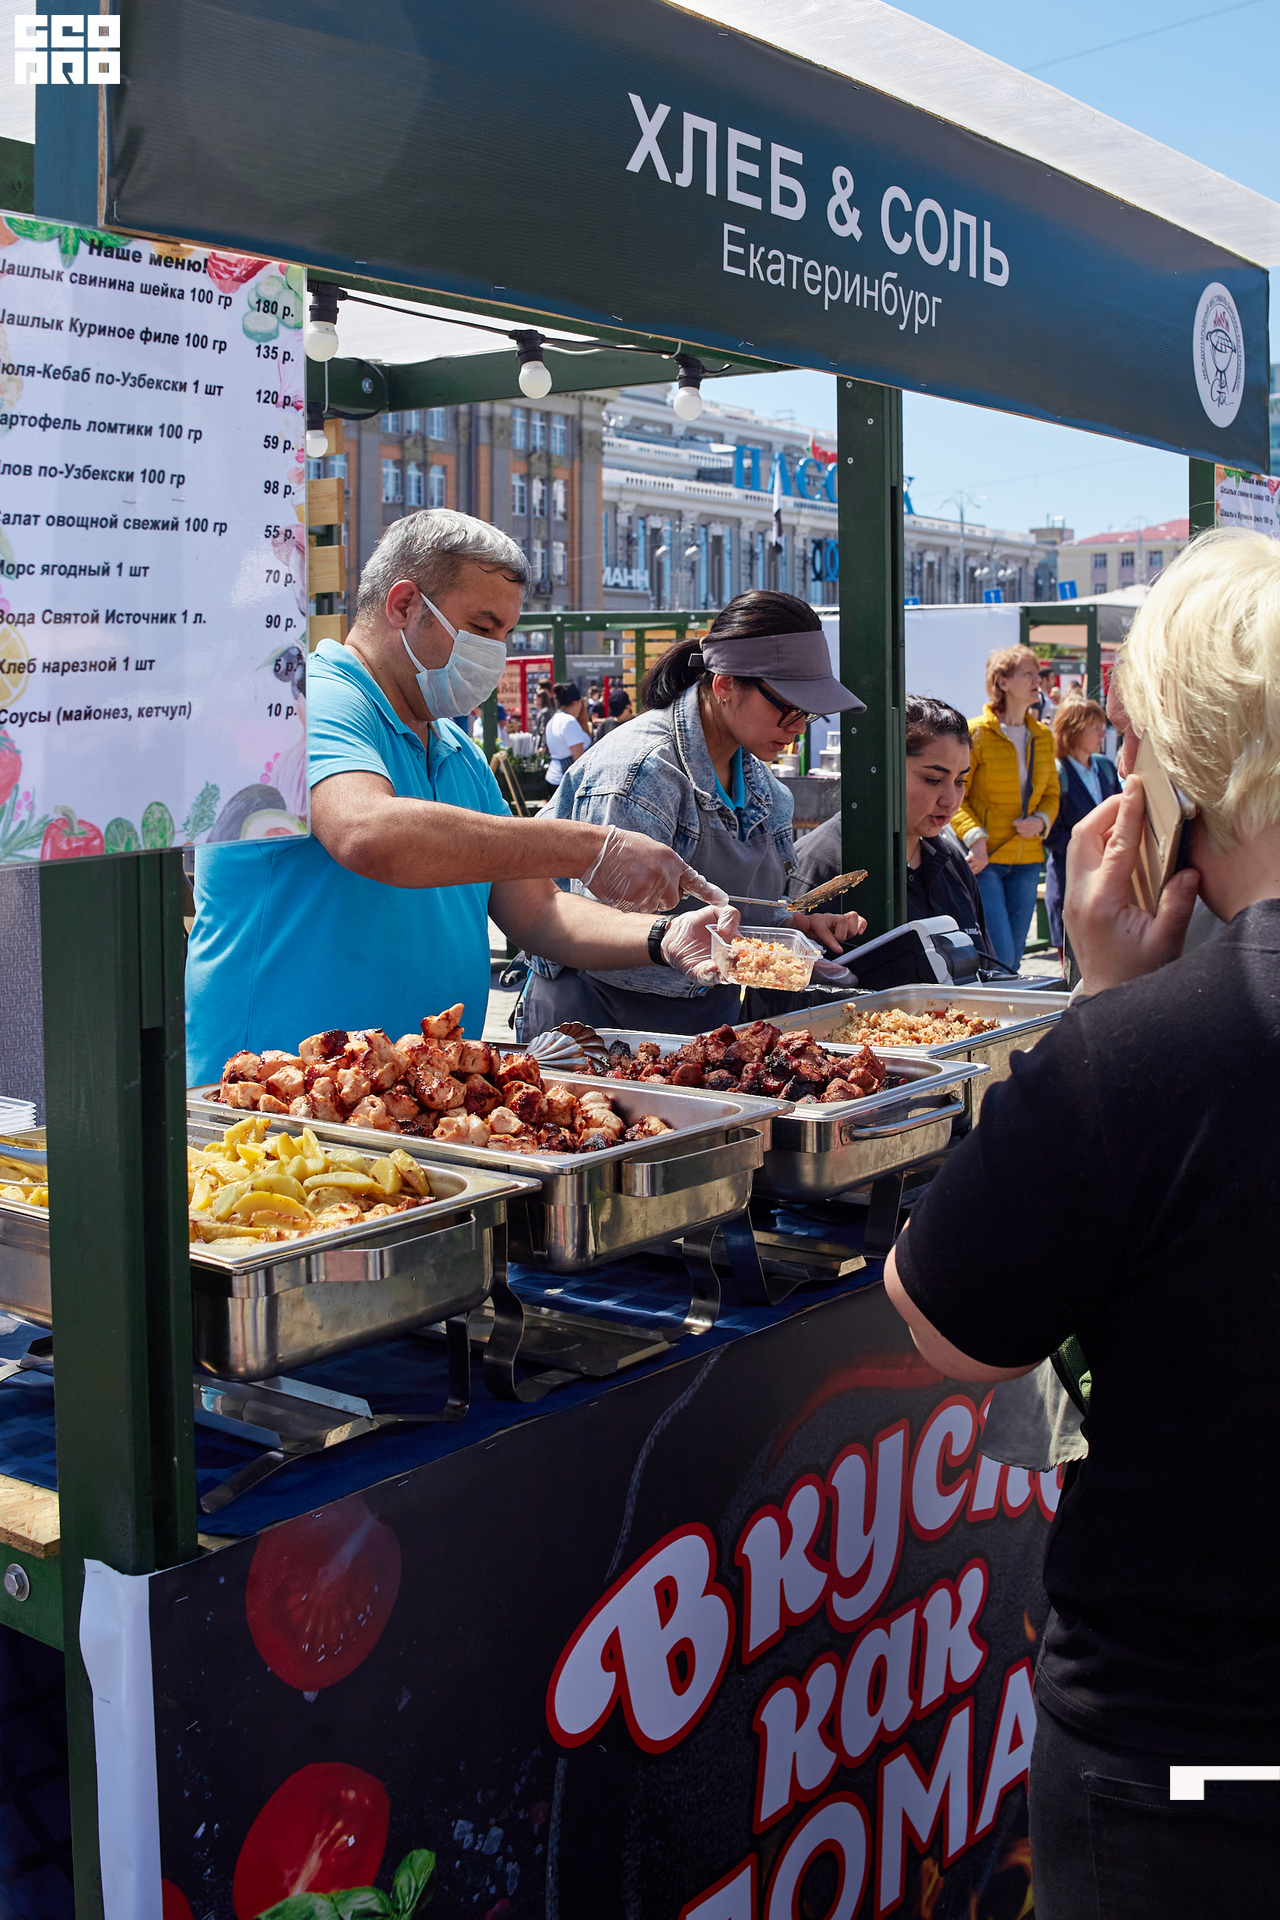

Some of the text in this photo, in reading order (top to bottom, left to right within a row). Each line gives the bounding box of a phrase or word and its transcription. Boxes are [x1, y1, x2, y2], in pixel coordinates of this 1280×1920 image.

[626, 92, 1010, 287] ХЛЕБ & СОЛЬ
[89, 239, 208, 274] Наше меню!
[723, 222, 943, 334] Екатеринбург
[69, 271, 135, 293] свинина
[140, 282, 185, 301] шейка
[190, 287, 213, 304] 100
[218, 294, 233, 308] гр
[255, 299, 294, 318] 180 р.
[69, 317, 135, 340] Куриное
[139, 327, 180, 345] филе
[185, 333, 208, 350] 100
[213, 338, 227, 354] гр
[255, 344, 294, 364] 135 р.
[0, 361, 223, 396] юля-Кебаб по-Узбекски 1 шт
[256, 389, 294, 409] 120 р.
[0, 413, 202, 442] артофель ломтики 100 гр
[263, 434, 295, 452] 59 р.
[0, 460, 185, 488] лов по-Узбекски 100 гр
[264, 480, 295, 499] 98 р.
[0, 511, 228, 537] алат овощной свежий 100 гр
[264, 525, 295, 542] 55 р.
[41, 562, 110, 580] ягодный
[116, 562, 123, 576] 1
[129, 565, 150, 577] шт
[265, 570, 296, 587] 70 р.
[41, 610, 100, 625] Святой
[105, 610, 177, 625] Источник
[182, 610, 188, 624] 1
[193, 613, 207, 624] л.
[265, 615, 297, 631] 90 р.
[42, 657, 117, 674] нарезной
[123, 657, 129, 671] 1
[135, 659, 155, 671] шт
[285, 662, 297, 676] р.
[0, 702, 192, 727] Соусы (майонез, кетчуп)
[267, 703, 297, 720] 10 р.
[546, 1388, 1066, 1753] Вкус
[753, 1557, 988, 1834] как
